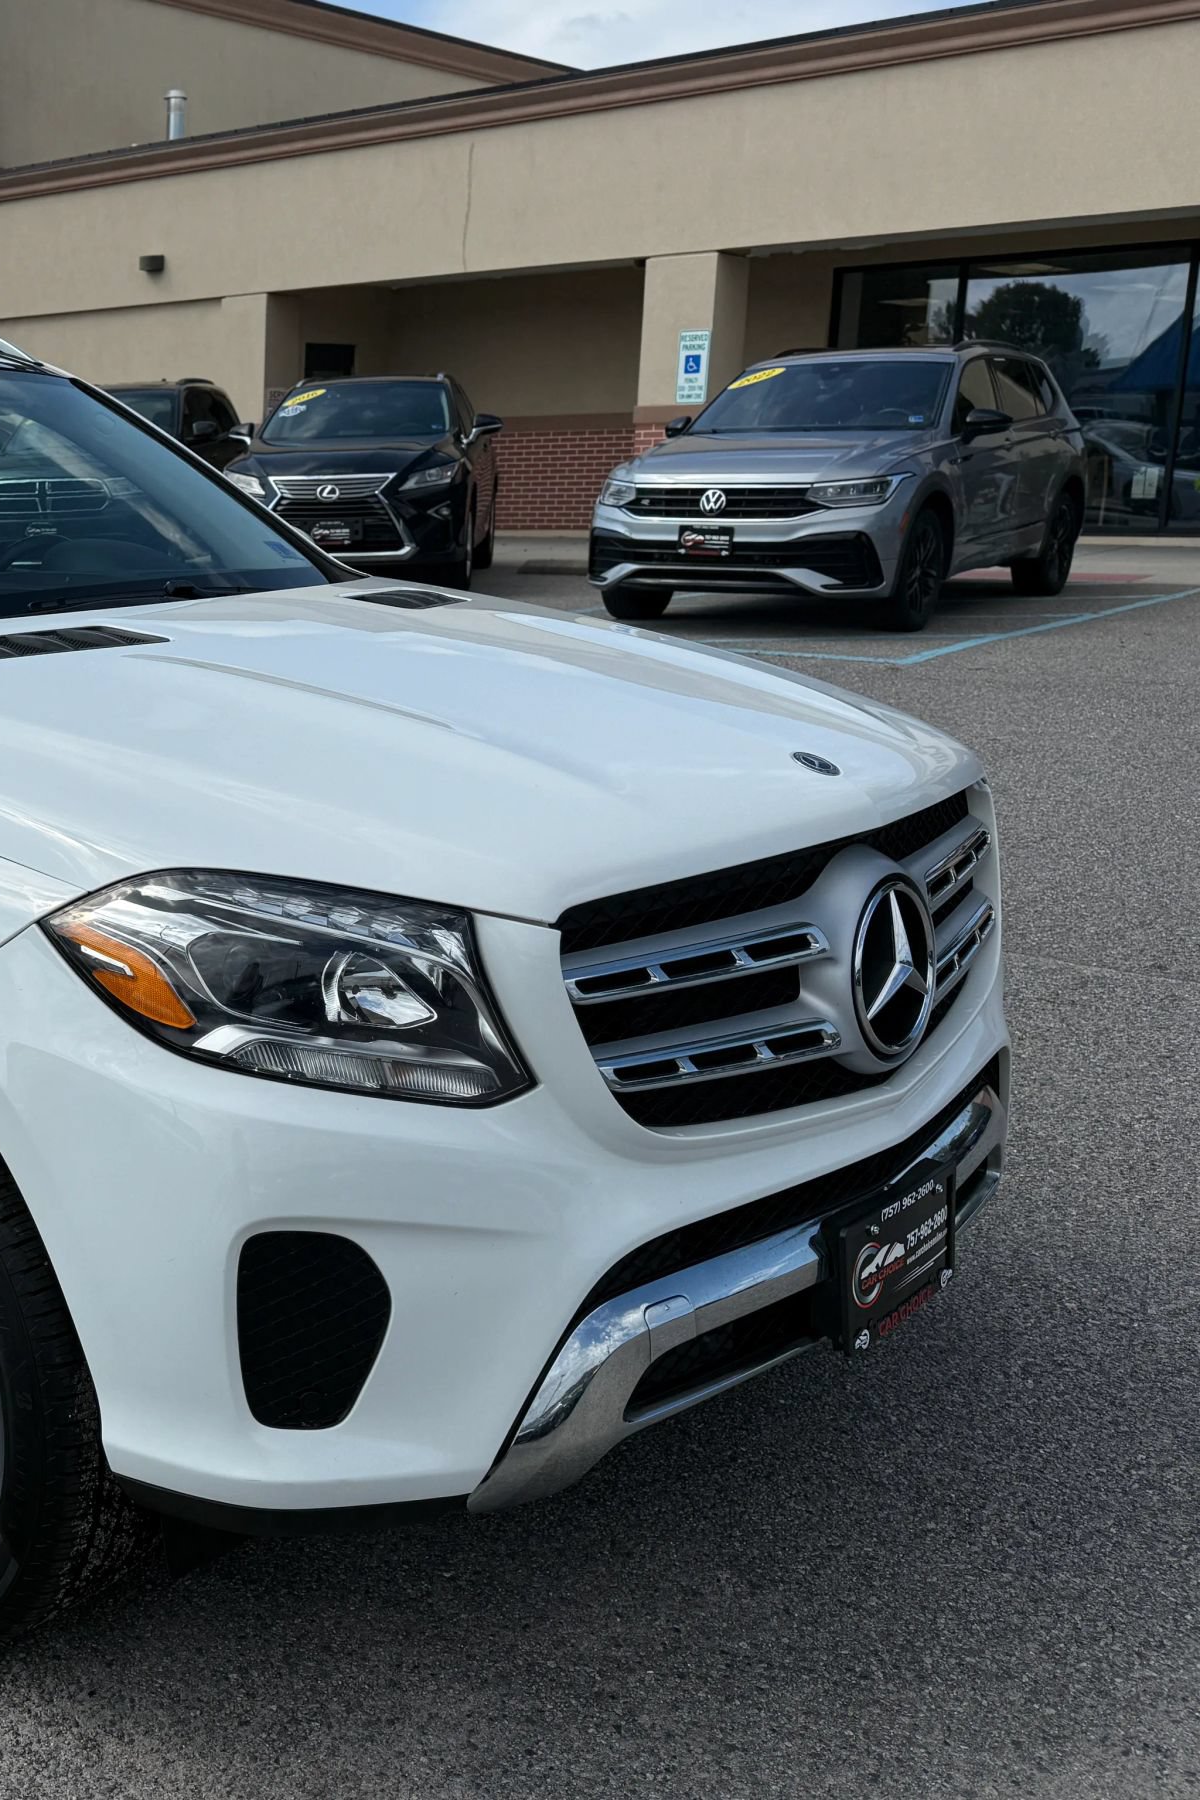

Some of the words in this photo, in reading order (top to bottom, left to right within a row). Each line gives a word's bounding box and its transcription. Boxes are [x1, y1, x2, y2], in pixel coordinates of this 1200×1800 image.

[682, 343, 705, 352] PARKING
[881, 1200, 901, 1222] (757)
[902, 1179, 934, 1210] 962-2600
[879, 1311, 900, 1336] CAR
[900, 1284, 935, 1319] CHOICE
